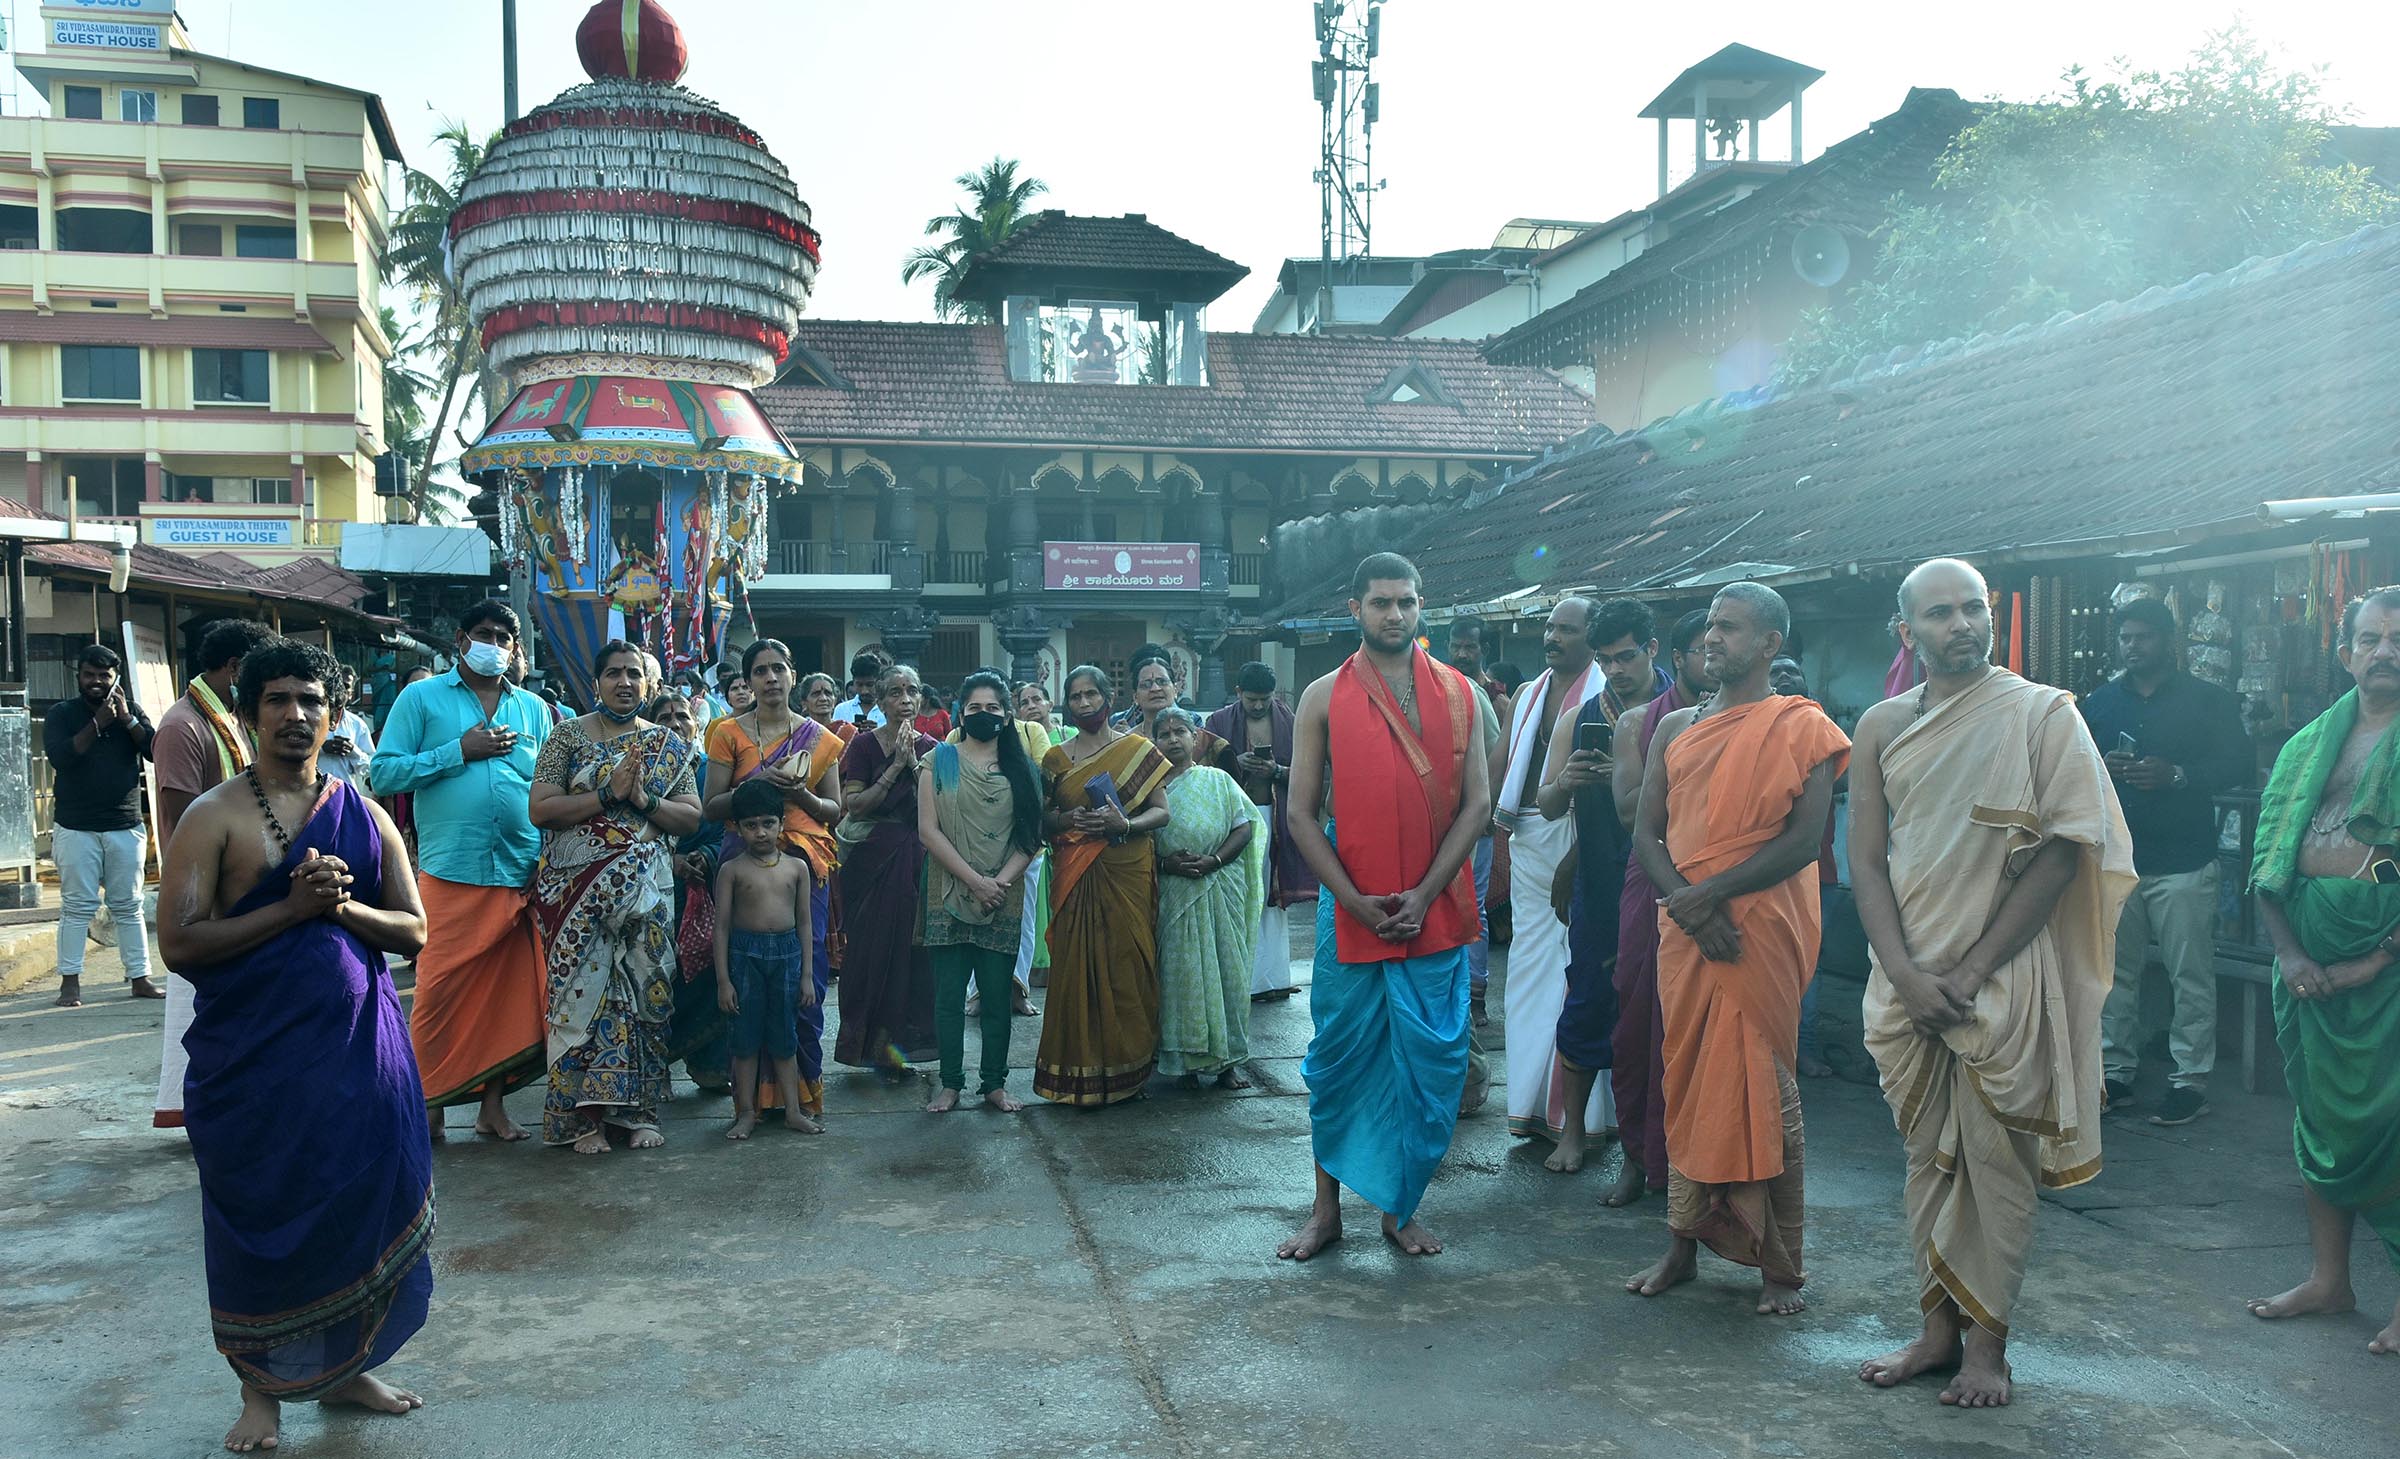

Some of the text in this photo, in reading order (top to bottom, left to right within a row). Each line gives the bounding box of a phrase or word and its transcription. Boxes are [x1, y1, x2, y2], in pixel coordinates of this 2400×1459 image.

[57, 21, 156, 36] SRI VIDYASAMUDRA THIRTHA
[57, 32, 156, 48] GUEST HOUSE
[156, 520, 288, 531] SRI VIDYASAMUDRA THIRTHA
[170, 531, 278, 543] GUEST HOUSE
